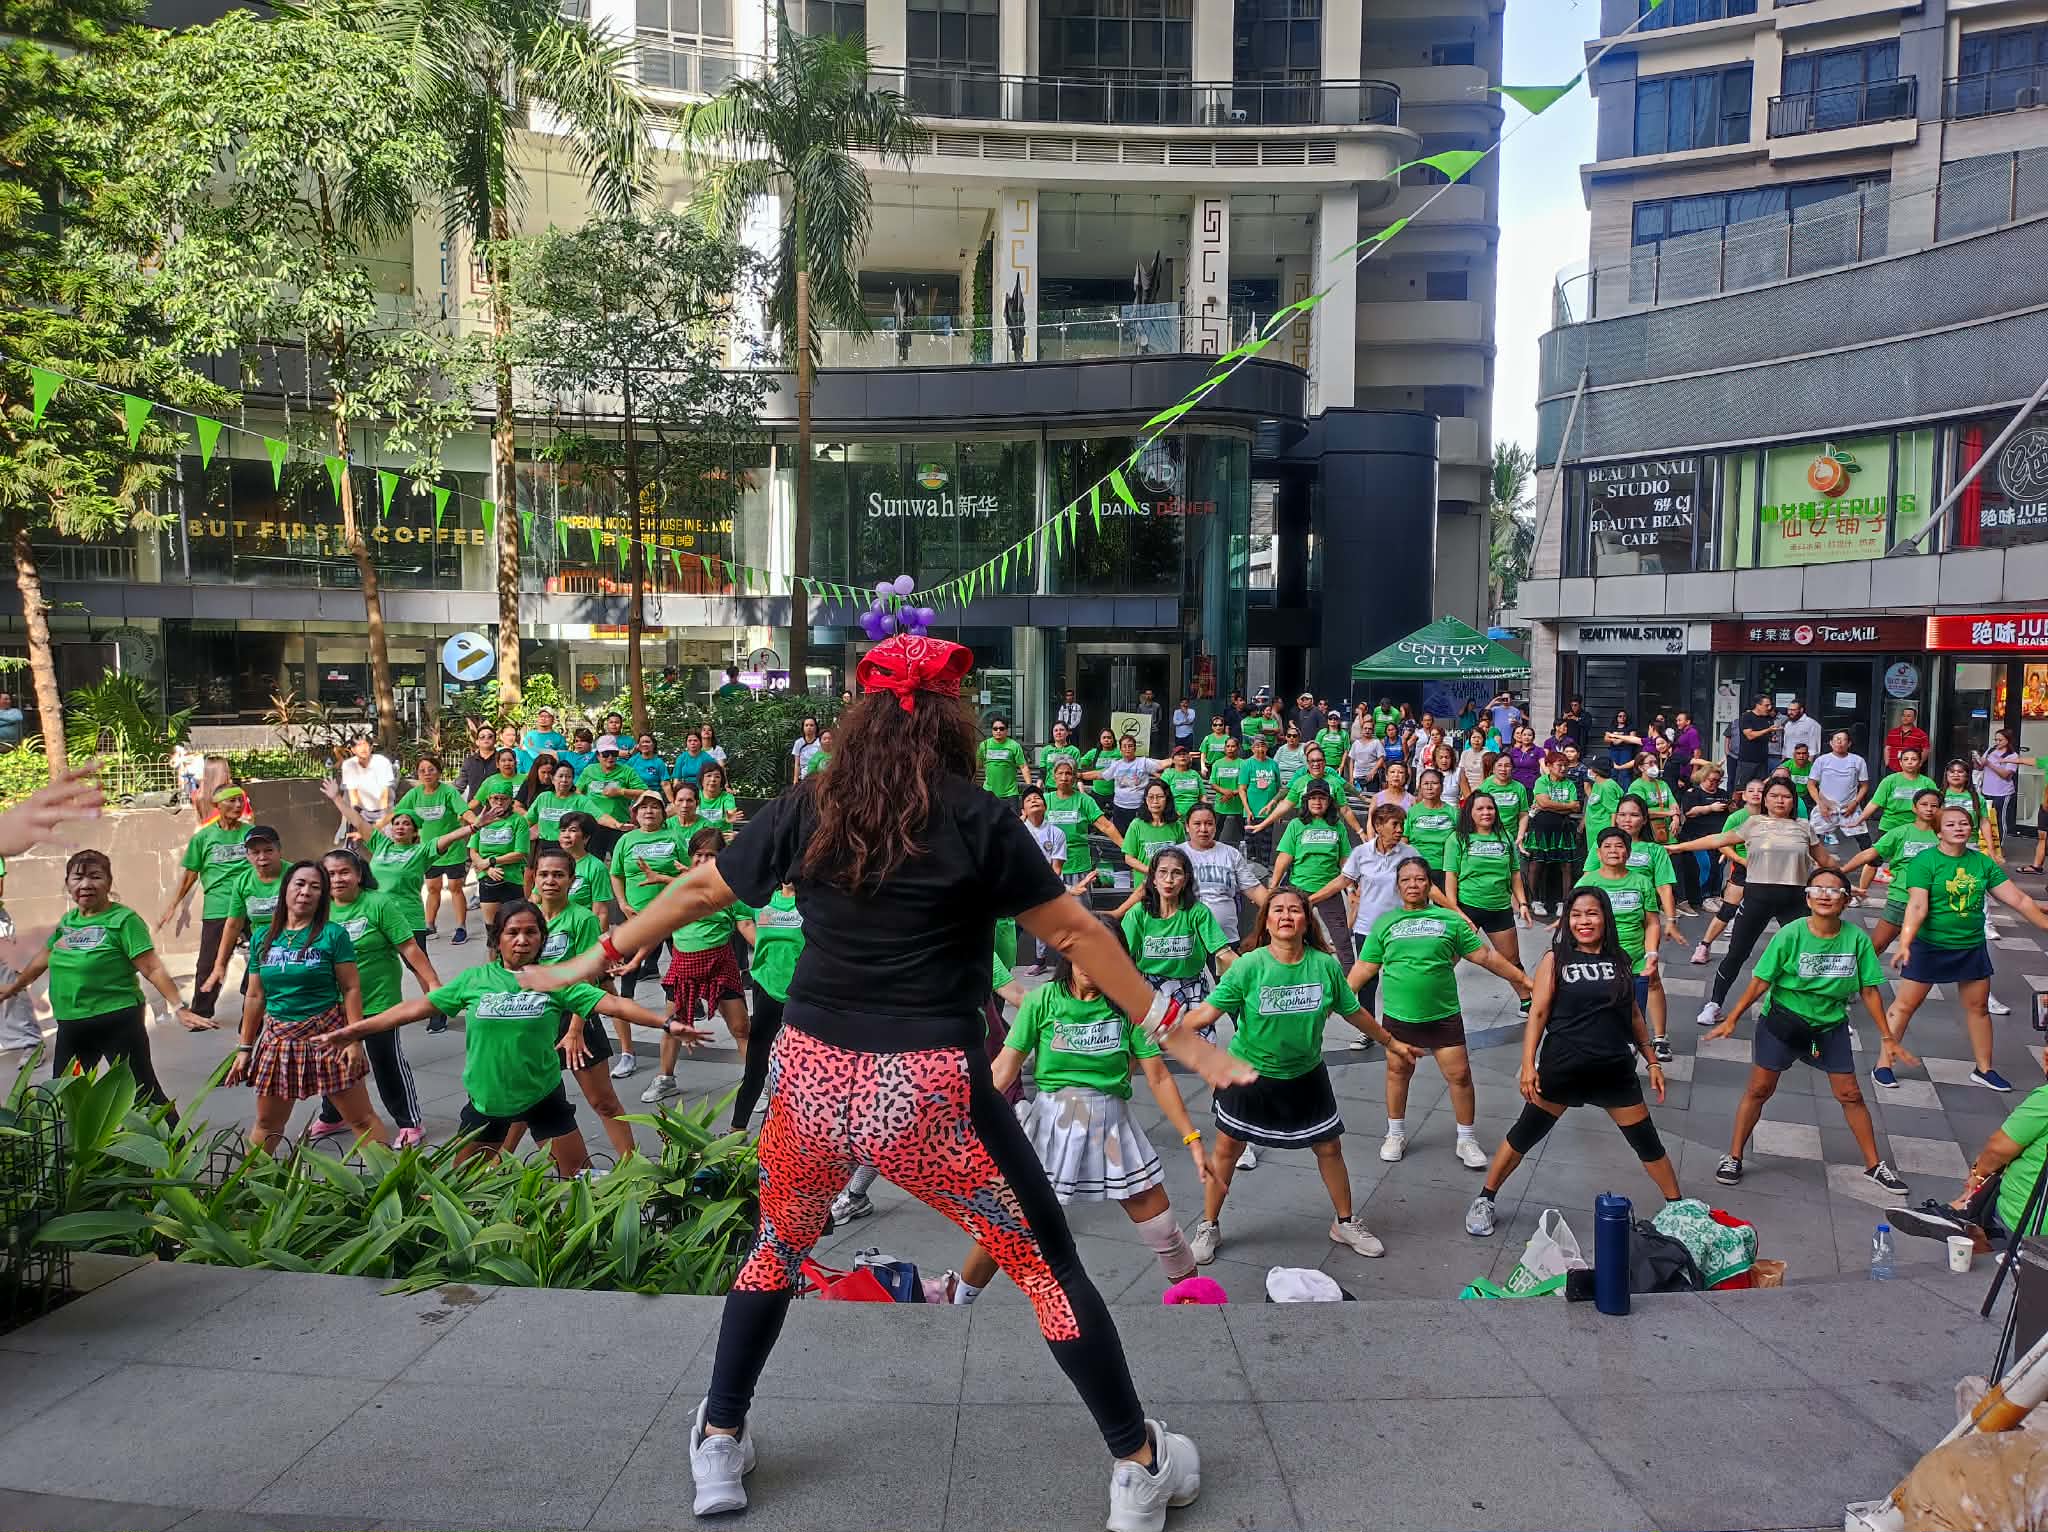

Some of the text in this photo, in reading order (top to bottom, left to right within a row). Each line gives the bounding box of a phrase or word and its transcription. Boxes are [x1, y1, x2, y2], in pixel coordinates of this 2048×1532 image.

[1588, 459, 1697, 483] BEAUTY NAIL
[1607, 480, 1670, 498] STUDIO
[868, 492, 955, 518] Sunwah
[958, 495, 999, 519] 新华
[1590, 513, 1695, 533] BEAUTY BEAN
[188, 519, 248, 537] BUT
[371, 526, 486, 545] COFFEE
[1621, 532, 1659, 546] CAFE
[1580, 628, 1619, 639] BEAUTY
[1643, 628, 1683, 640] STUDIO
[1398, 642, 1489, 656] CENTURY
[1414, 655, 1465, 667] CITY
[1274, 996, 1319, 1011] Kapihan
[1066, 1034, 1119, 1049] Kapihan
